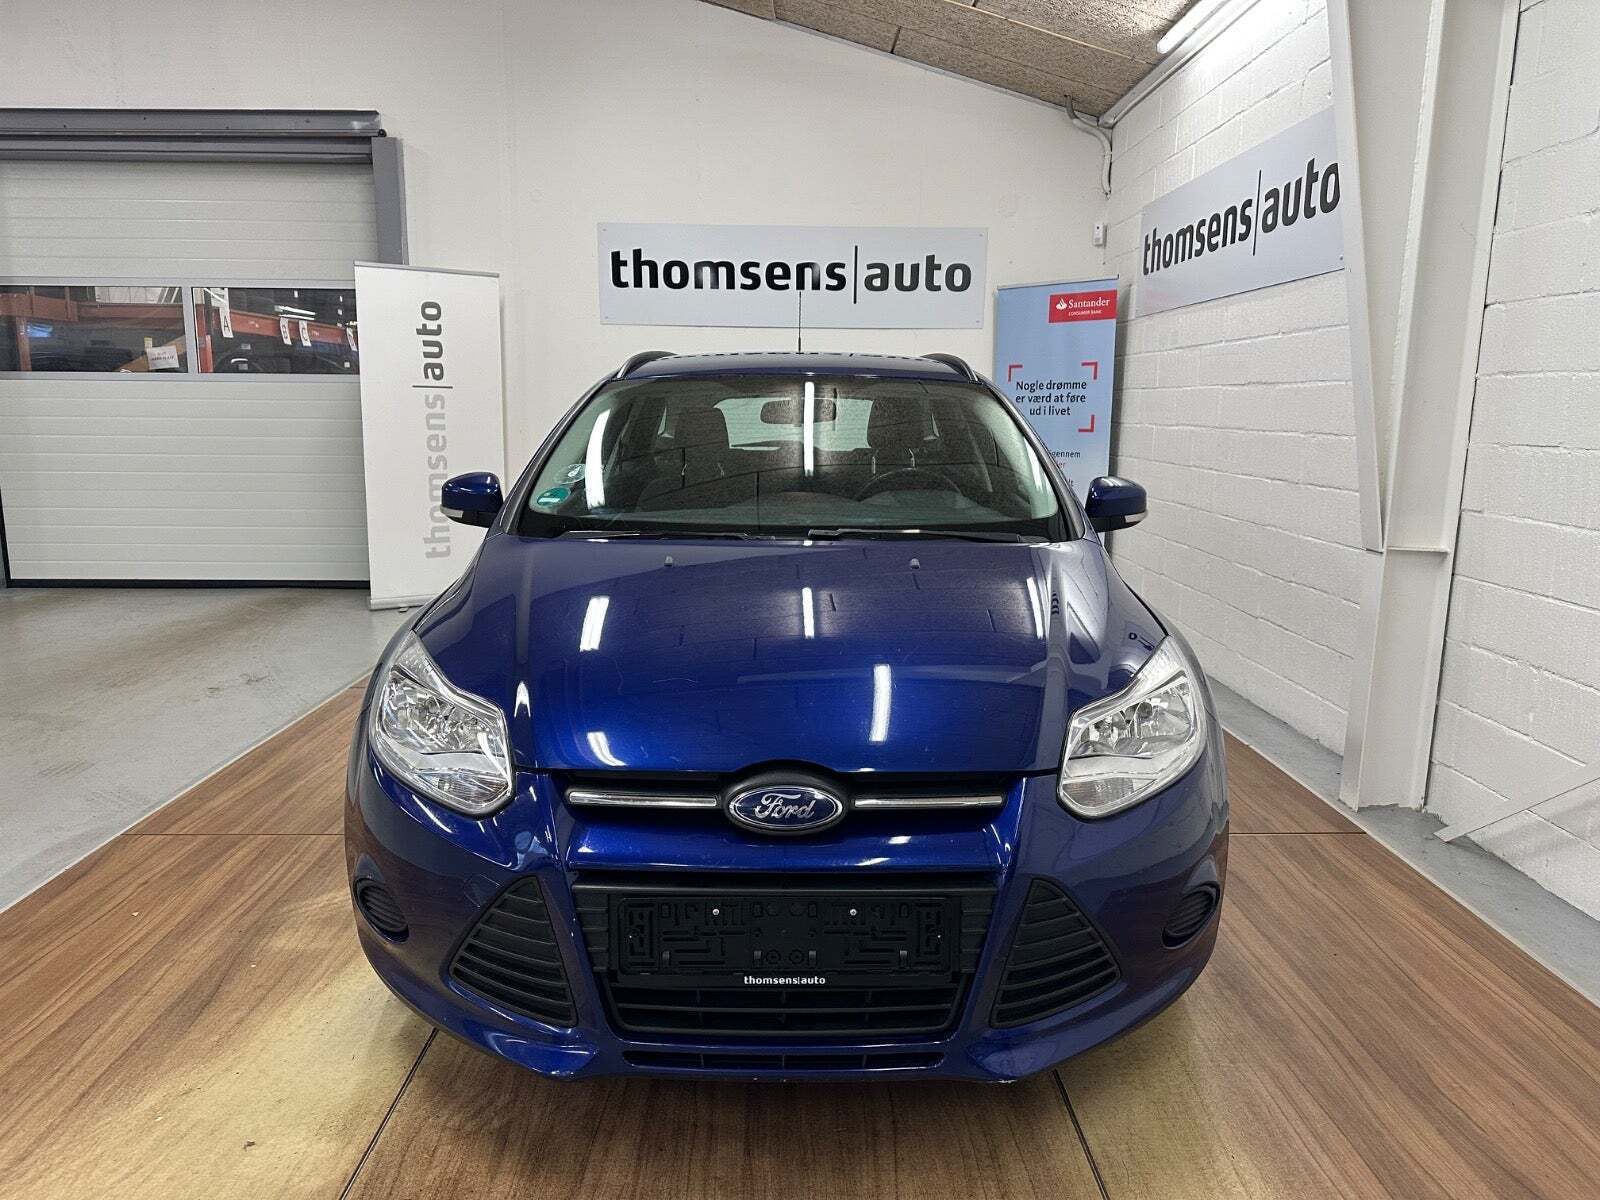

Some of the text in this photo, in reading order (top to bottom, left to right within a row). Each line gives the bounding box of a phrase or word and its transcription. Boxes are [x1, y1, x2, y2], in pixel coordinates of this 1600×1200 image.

[1261, 157, 1340, 233] auto
[863, 254, 972, 292] auto
[1068, 297, 1110, 309] Santander
[416, 301, 444, 381] auto
[1016, 380, 1087, 392] Nogle drømme
[1015, 393, 1086, 403] er værd at føre
[1029, 405, 1071, 416] ud i livet
[754, 793, 816, 819] Ford
[800, 975, 826, 985] auto
